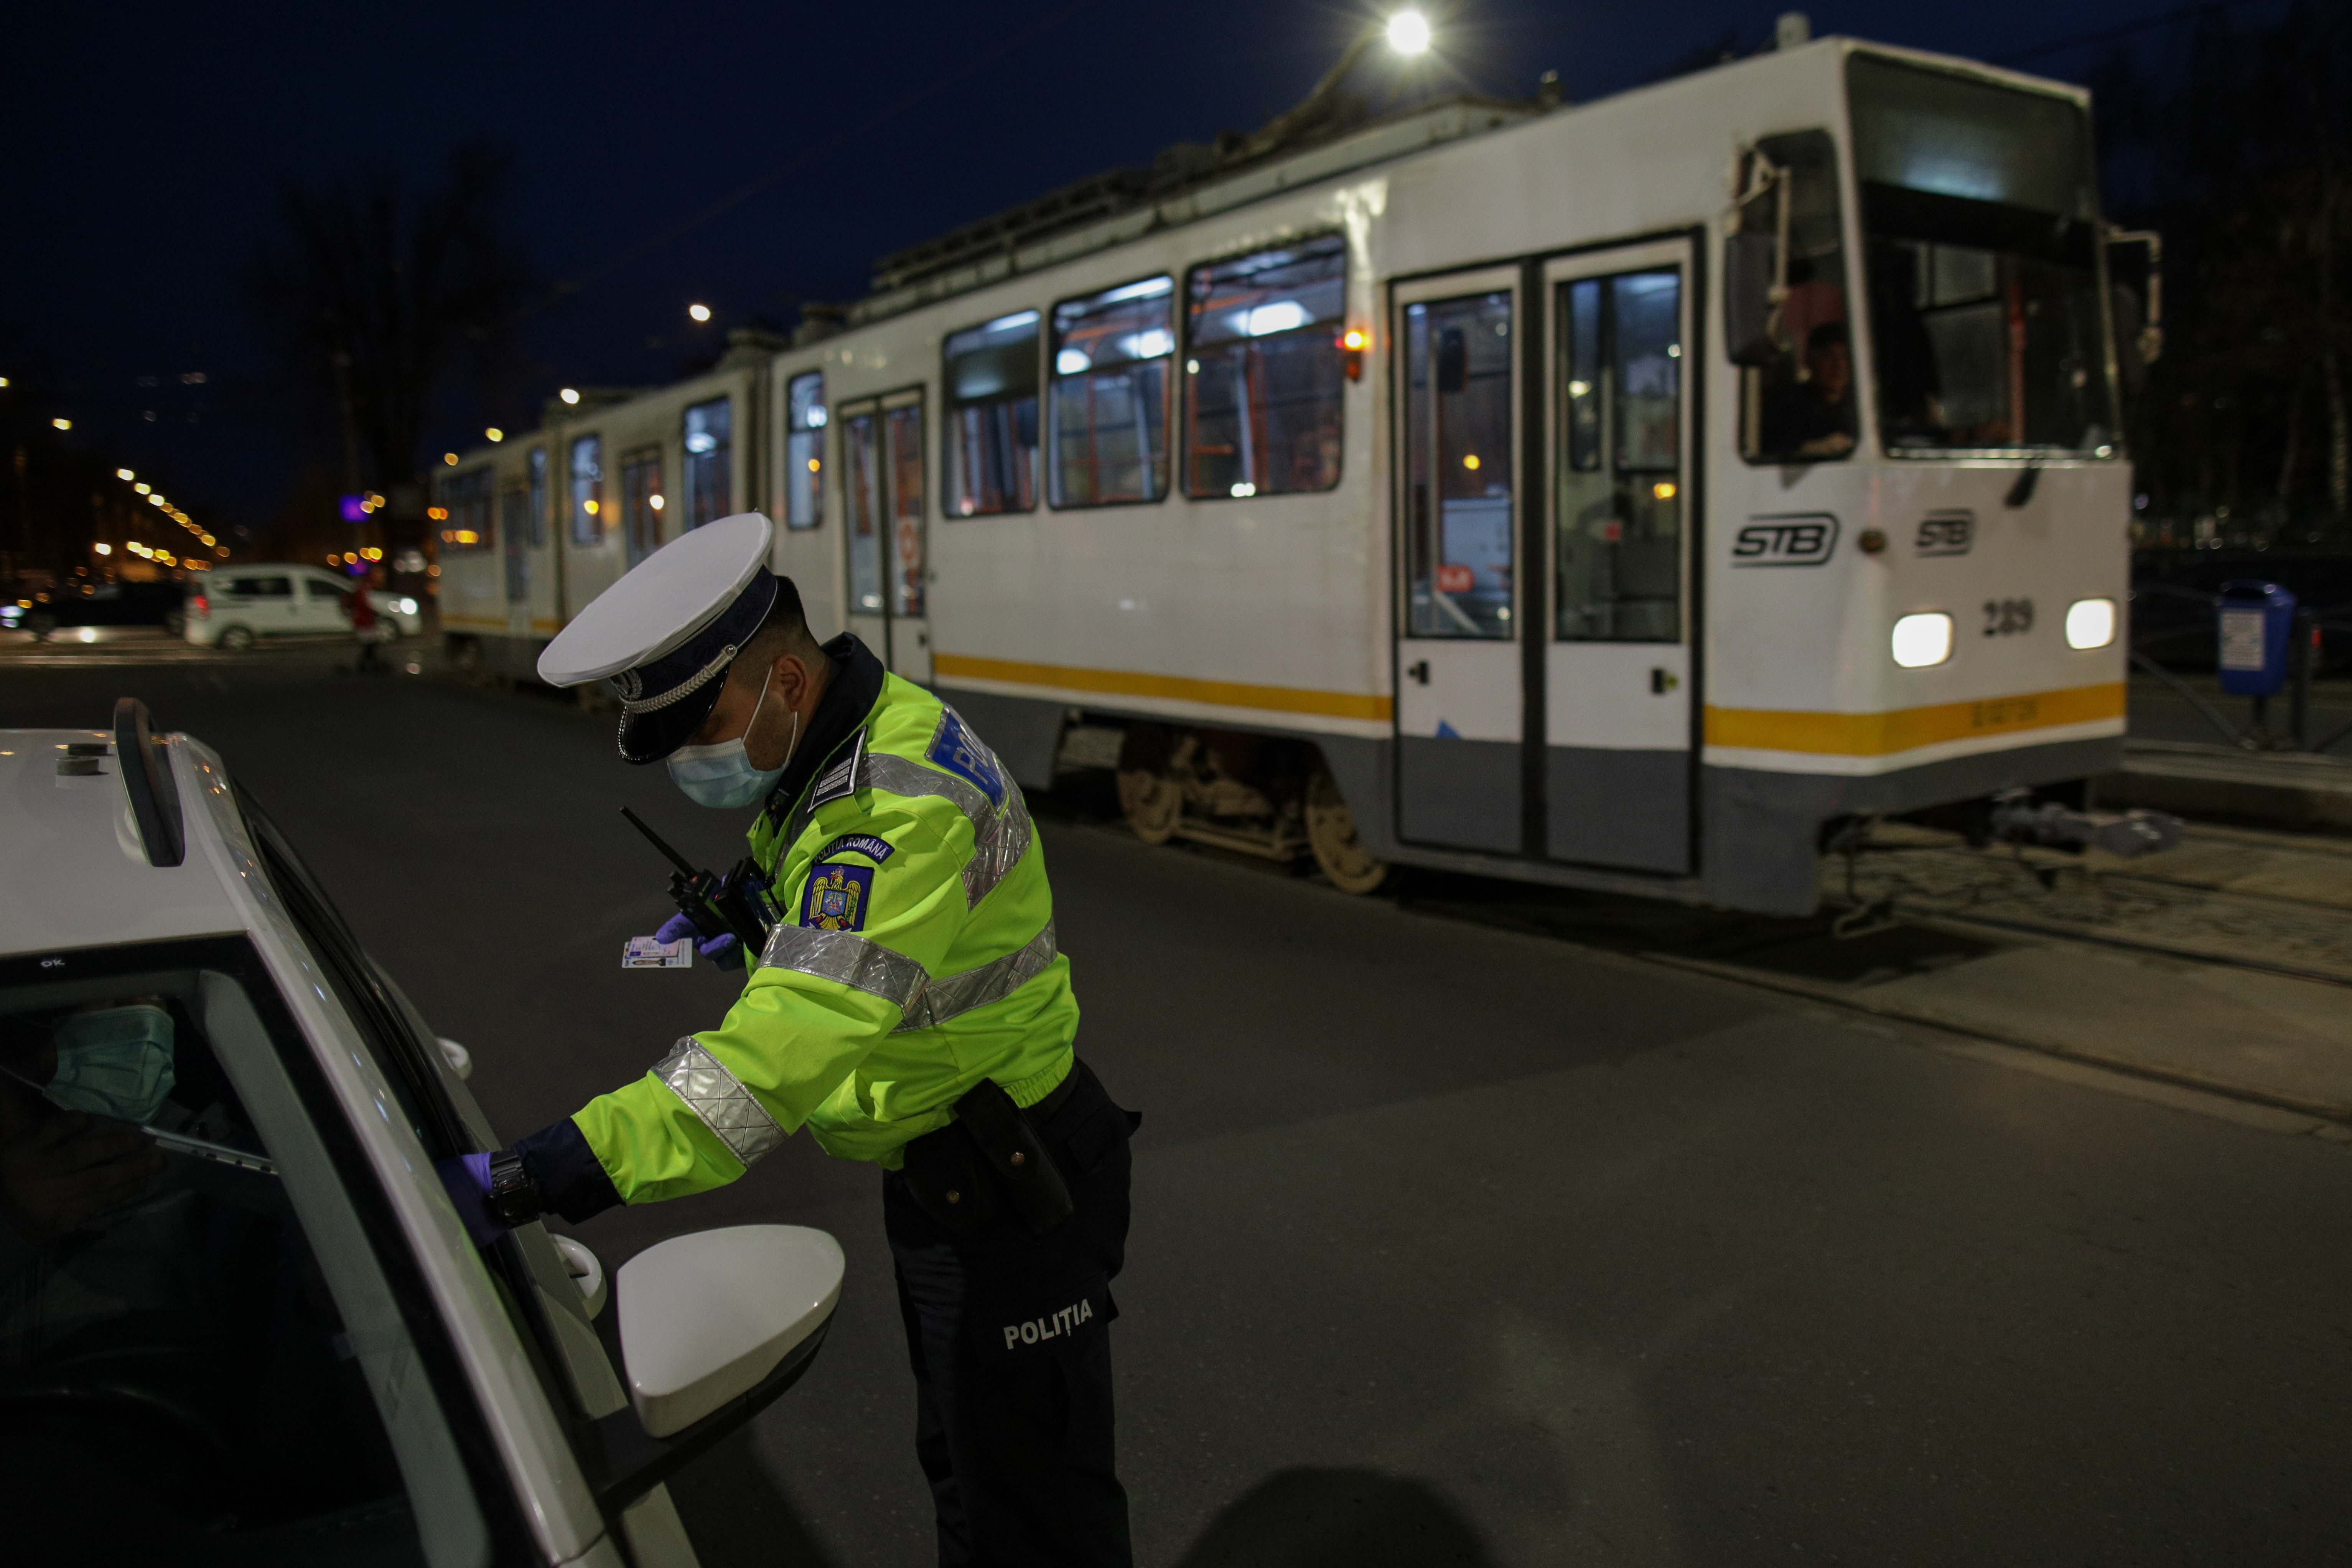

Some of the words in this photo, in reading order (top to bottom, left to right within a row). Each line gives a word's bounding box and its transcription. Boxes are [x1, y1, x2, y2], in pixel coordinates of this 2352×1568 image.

[1734, 524, 1825, 555] STB
[1916, 519, 1968, 546] STB
[846, 837, 889, 859] ROMÂNĂ
[1003, 1298, 1093, 1350] POLIȚIA
